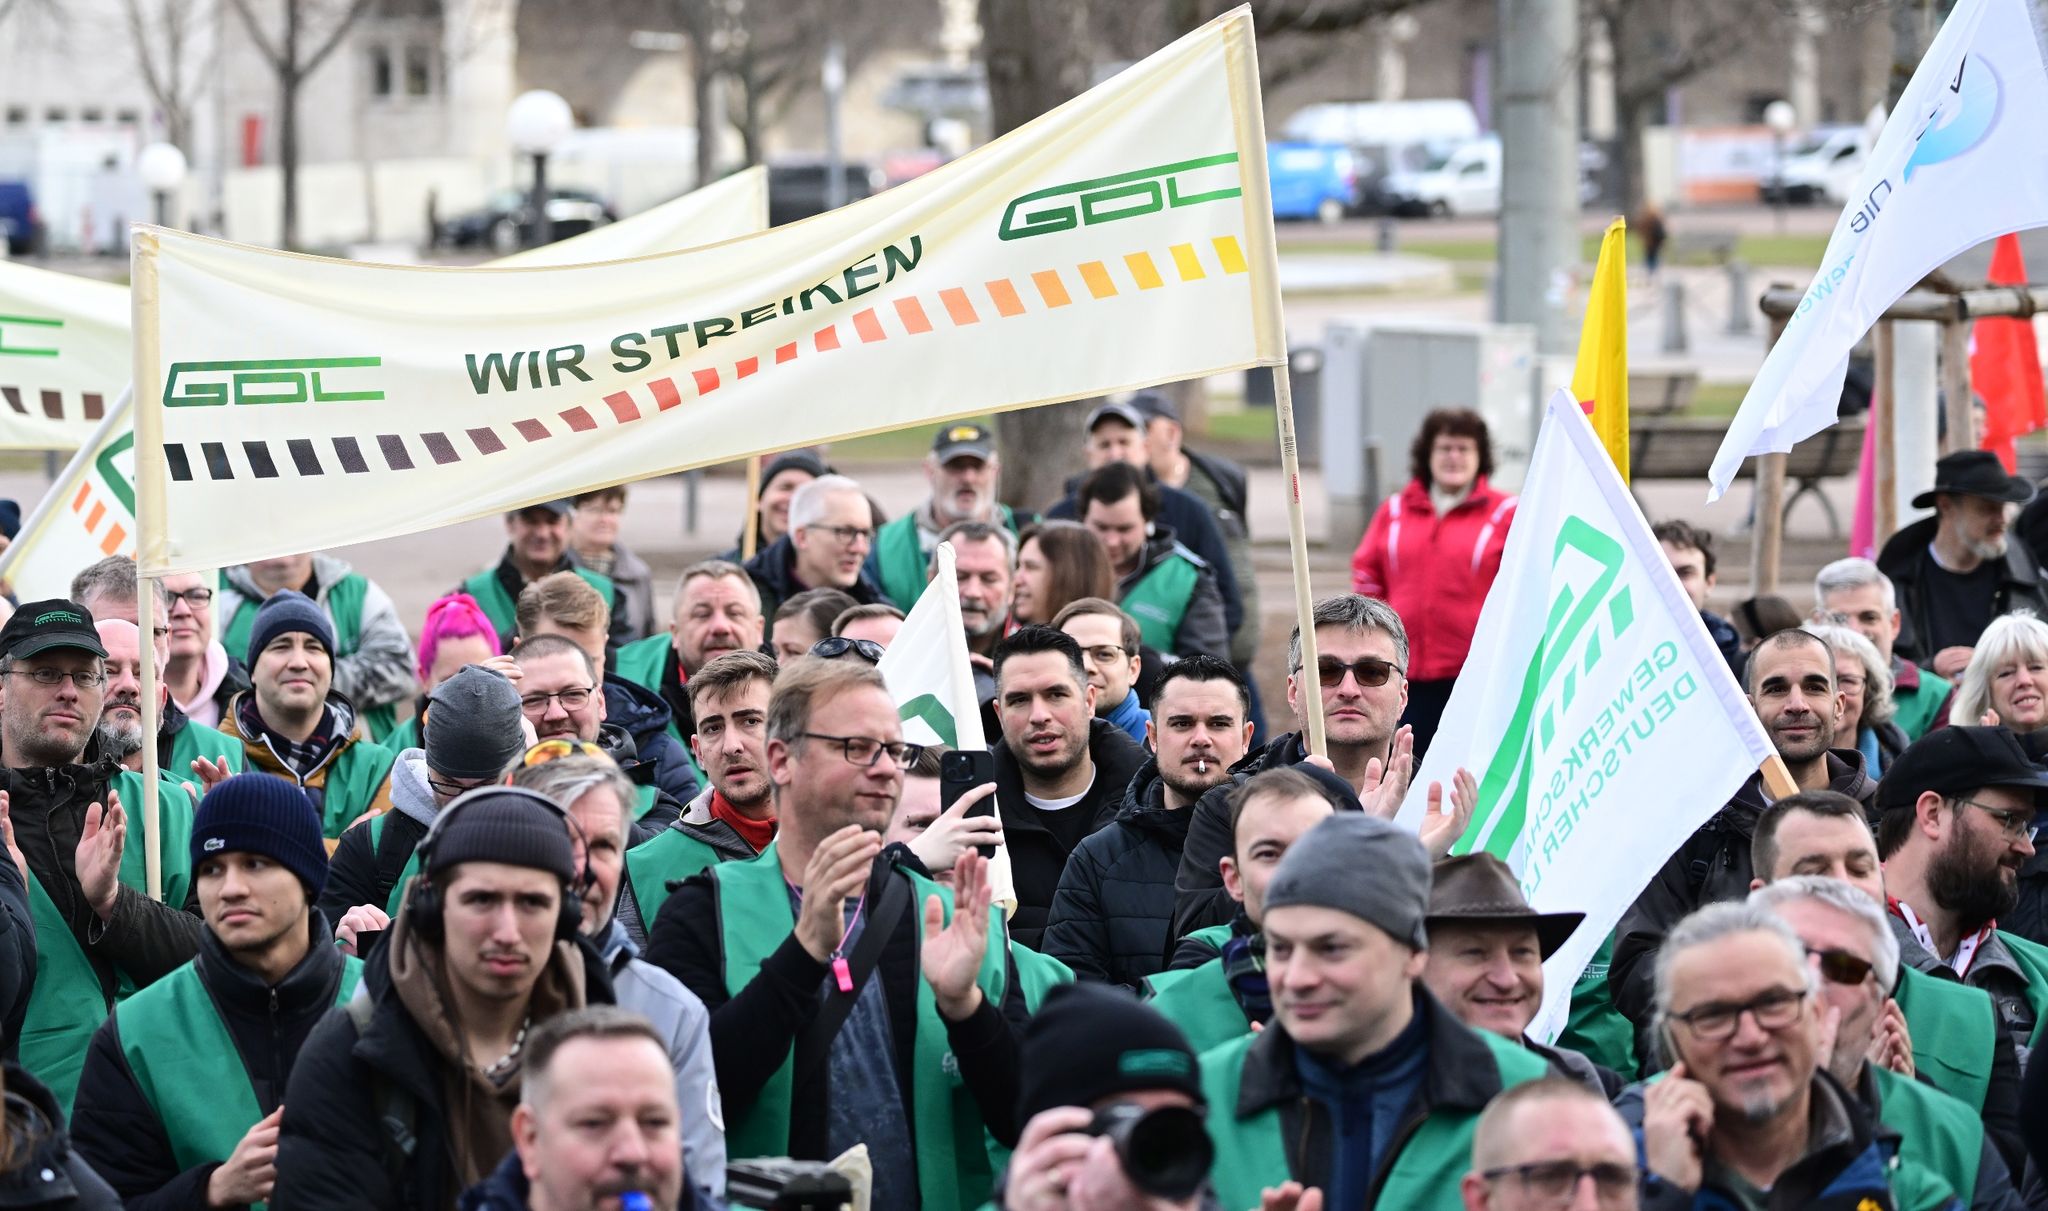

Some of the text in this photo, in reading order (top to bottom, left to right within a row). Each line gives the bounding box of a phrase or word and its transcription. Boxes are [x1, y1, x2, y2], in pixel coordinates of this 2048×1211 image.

[998, 152, 1242, 241] GDL
[465, 235, 922, 394] WIR STREIKEN
[163, 356, 385, 407] GDL
